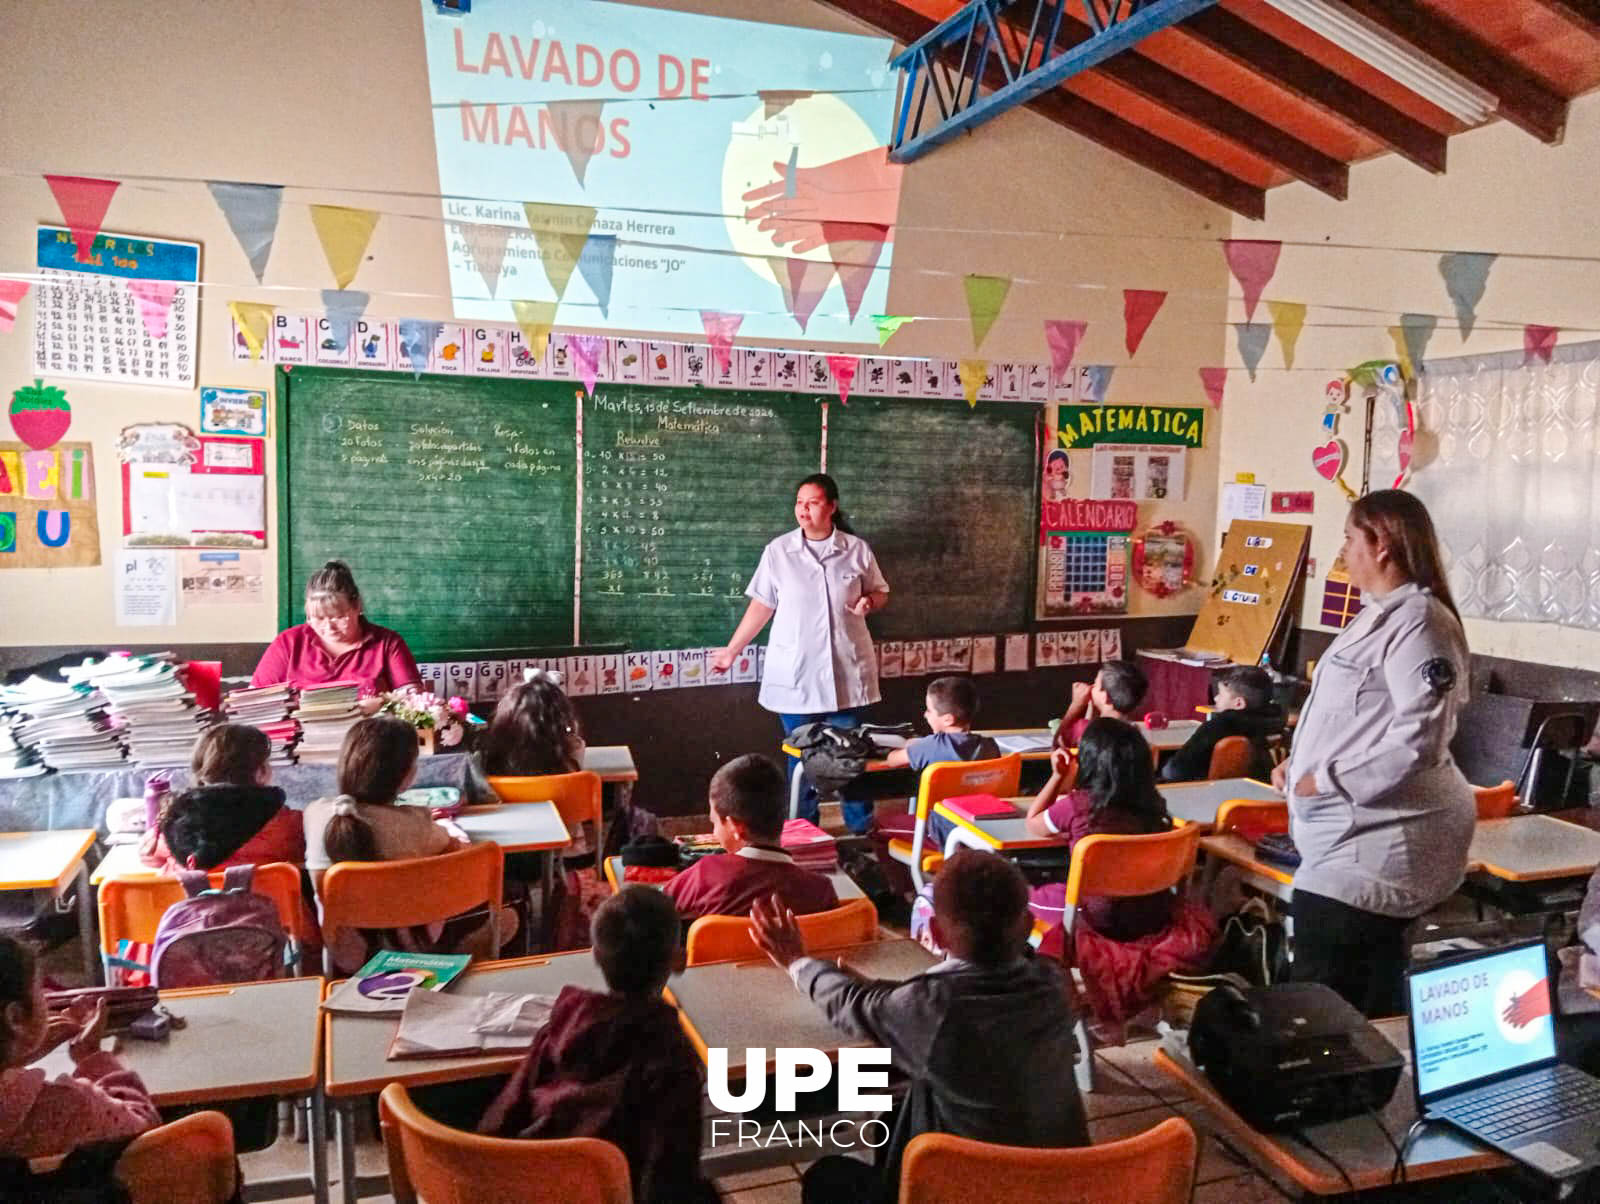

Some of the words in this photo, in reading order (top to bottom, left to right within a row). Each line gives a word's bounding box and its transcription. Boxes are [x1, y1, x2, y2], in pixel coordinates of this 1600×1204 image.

[453, 27, 641, 93] LAVADO
[657, 54, 711, 102] DE
[460, 99, 631, 159] MANOS
[447, 203, 473, 217] Lic.
[475, 205, 521, 221] Karina
[626, 217, 676, 235] Herrera
[277, 316, 287, 328] B
[319, 319, 329, 331] C
[358, 321, 368, 333] D
[475, 329, 486, 341] G
[511, 332, 520, 343] H
[684, 345, 694, 353] M
[950, 362, 957, 370] U
[1003, 364, 1013, 373] W
[1030, 365, 1038, 375] X
[1081, 367, 1089, 377] Z
[37, 510, 70, 548] U
[1046, 502, 1134, 528] CALENDARIO
[126, 560, 137, 574] pl
[451, 664, 460, 677] G
[465, 666, 473, 679] g
[511, 661, 521, 673] H
[628, 657, 635, 666] K
[641, 656, 649, 665] k
[659, 653, 665, 664] L
[1419, 977, 1470, 1003] LAVADO
[1473, 972, 1489, 989] DE
[1421, 1002, 1470, 1025] MANOS
